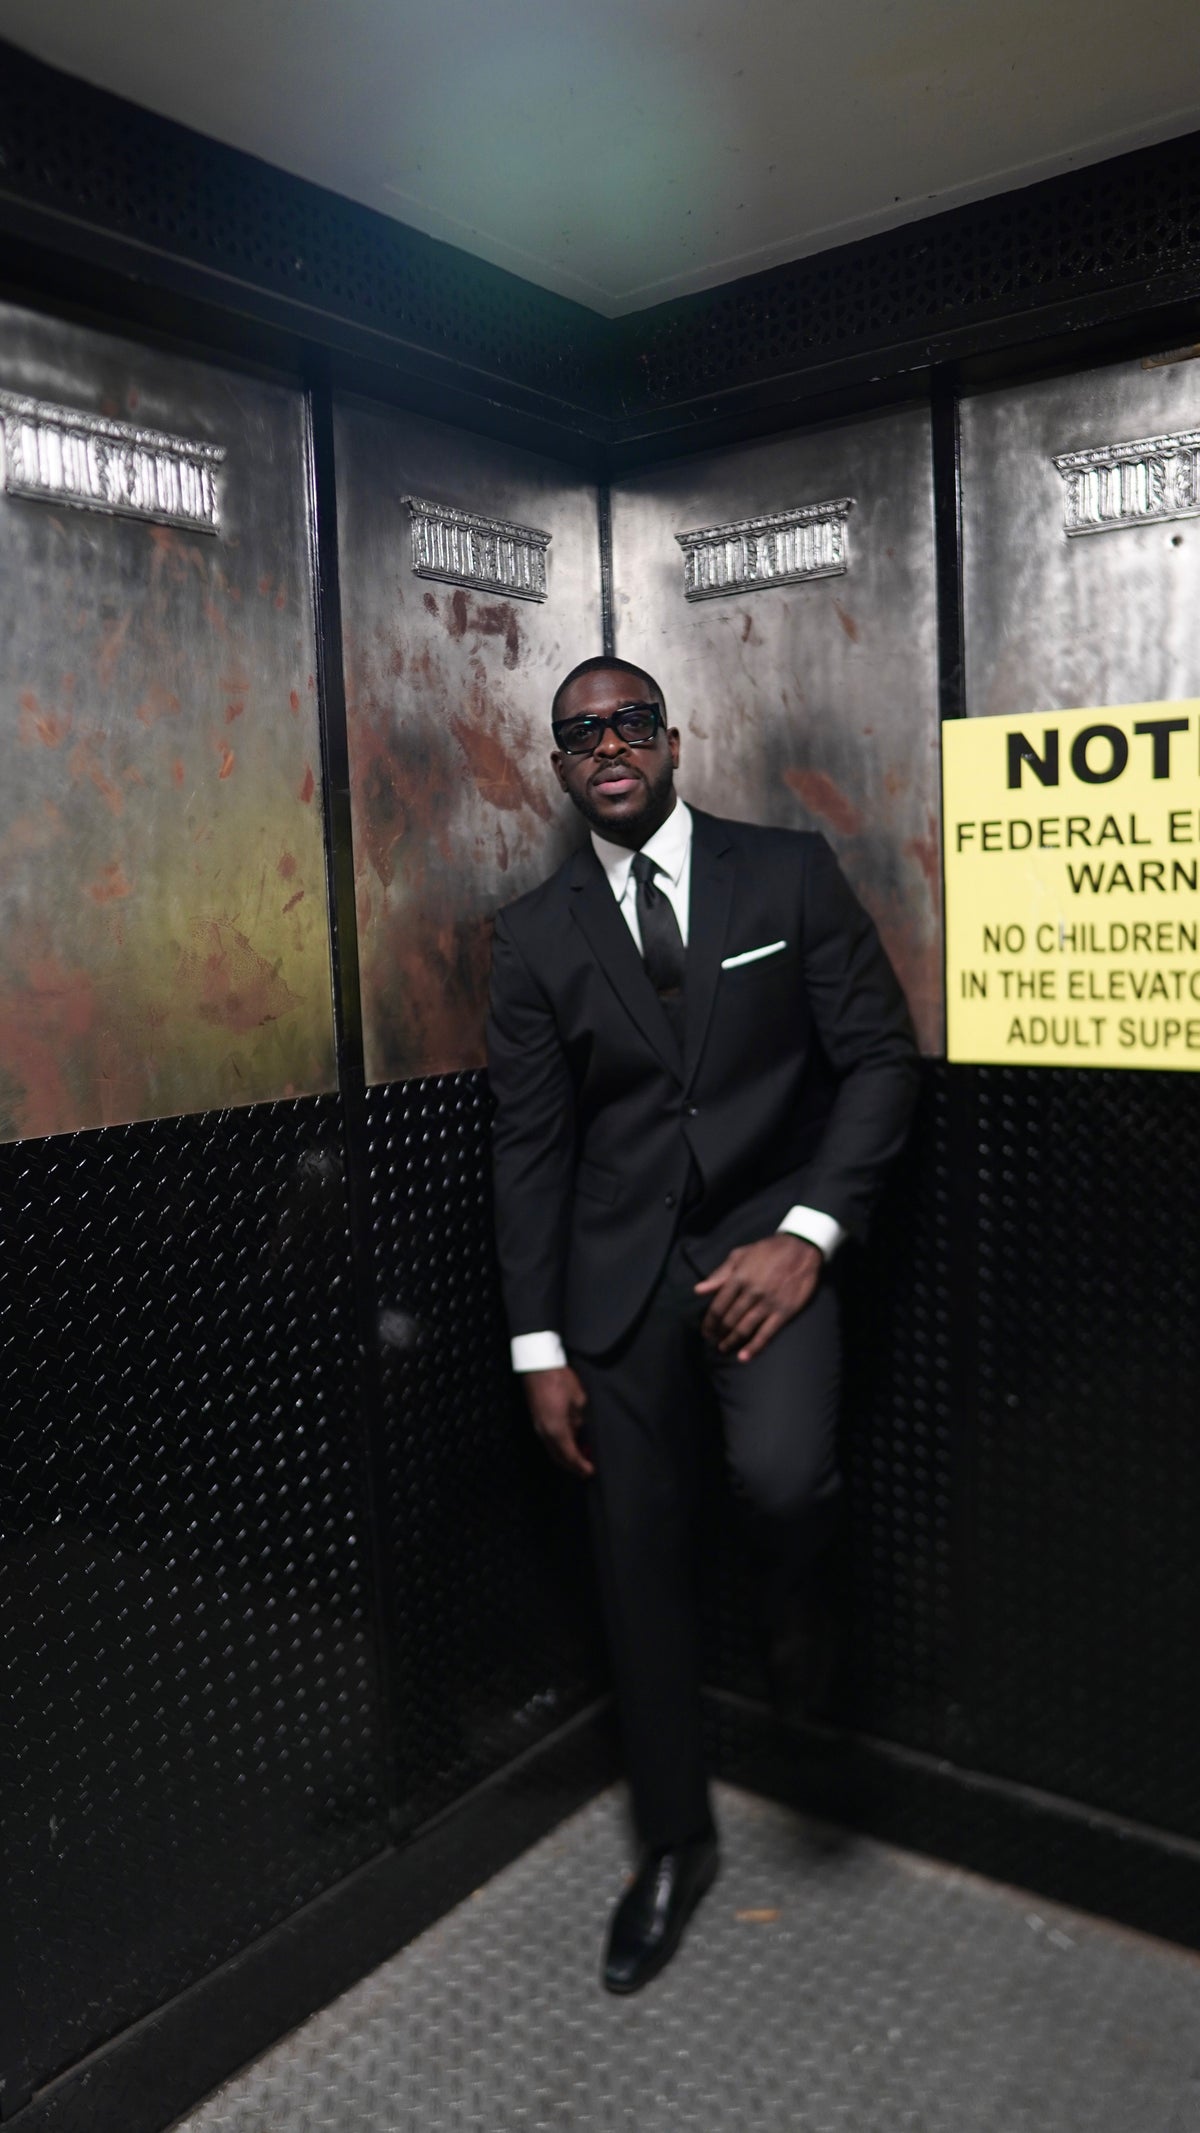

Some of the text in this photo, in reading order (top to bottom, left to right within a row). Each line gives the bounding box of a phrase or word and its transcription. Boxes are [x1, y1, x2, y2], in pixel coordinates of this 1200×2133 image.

[1006, 717, 1200, 789] NOT
[956, 810, 1200, 853] FEDERAL E
[1066, 859, 1198, 894] WARN
[984, 922, 1198, 954] NO CHILDREN
[961, 970, 987, 1000] IN
[998, 969, 1056, 1000] THE
[1007, 1016, 1200, 1050] ADULT SUPE
